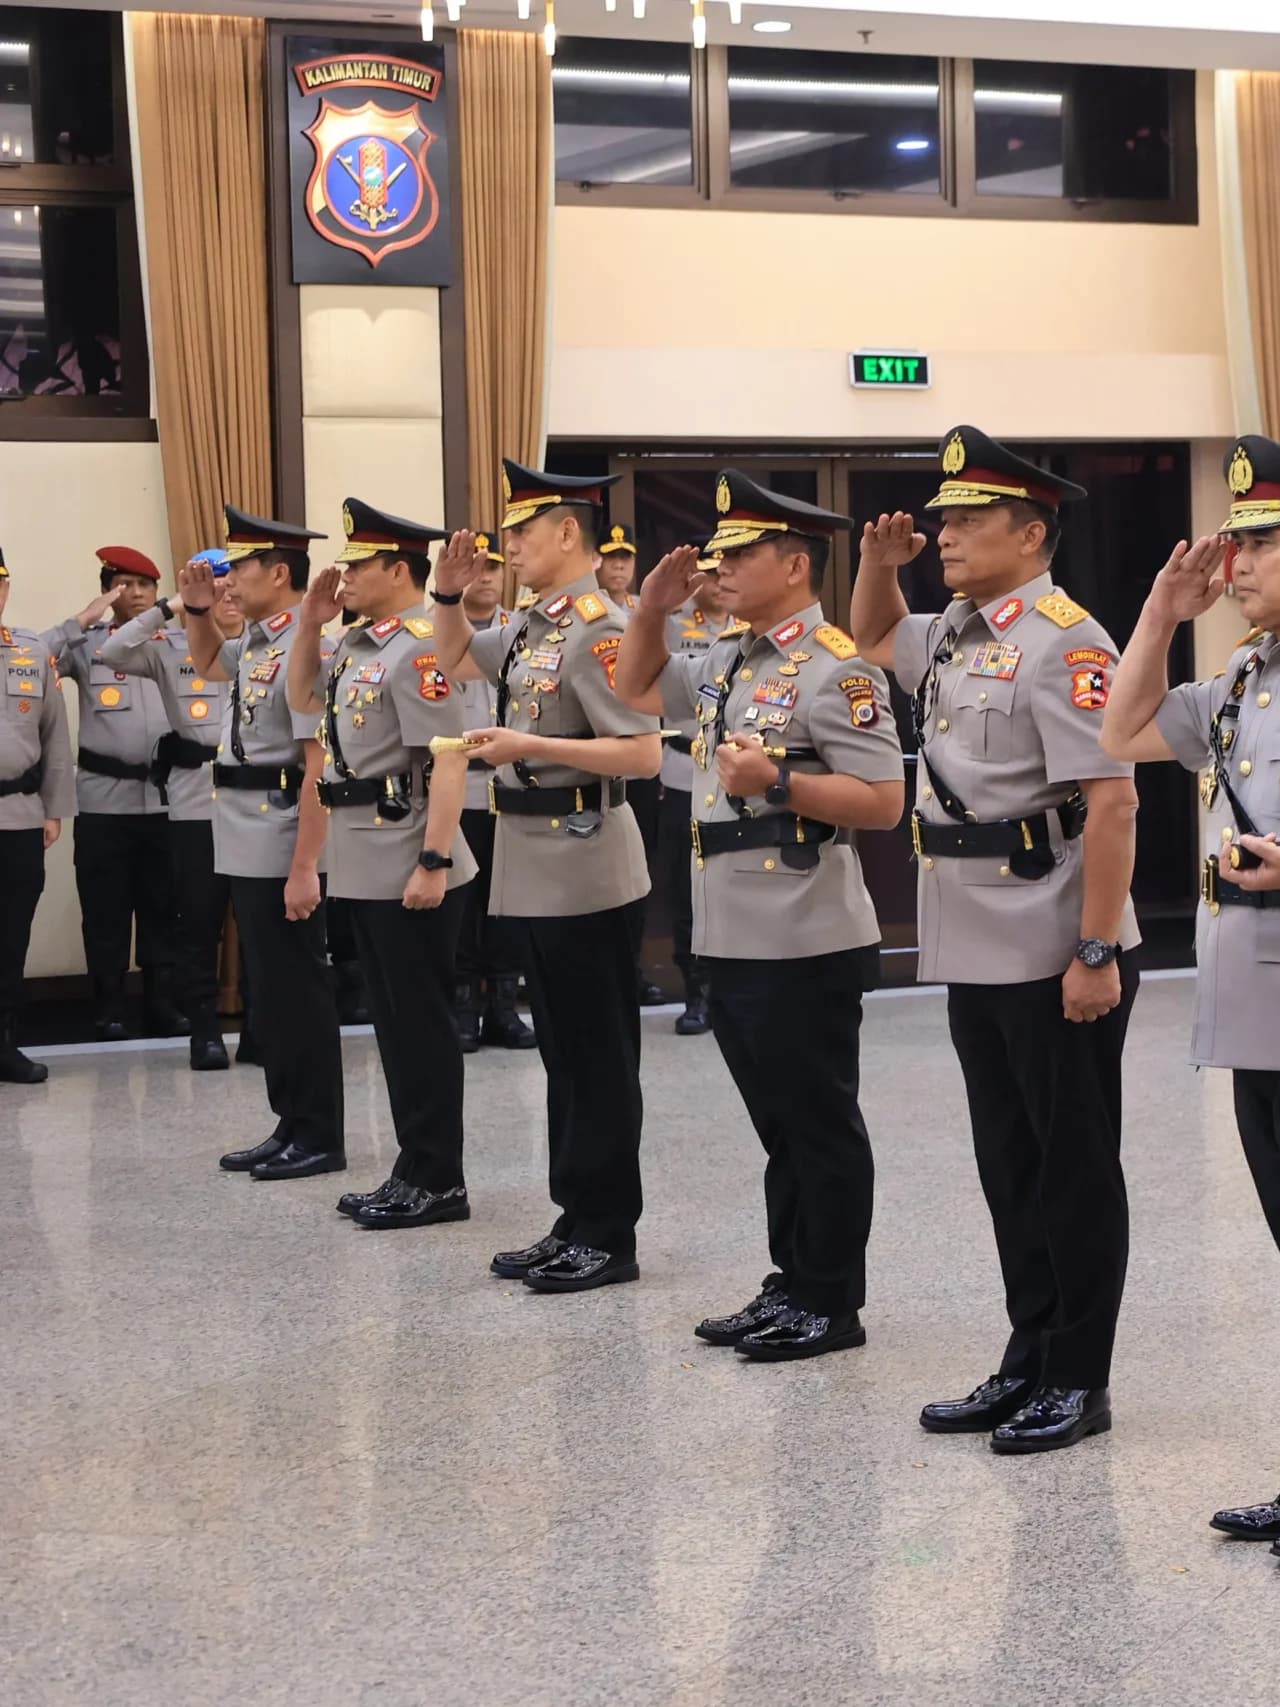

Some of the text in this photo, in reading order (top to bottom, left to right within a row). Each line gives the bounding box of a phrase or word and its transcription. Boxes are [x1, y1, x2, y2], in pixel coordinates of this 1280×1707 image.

[303, 61, 432, 91] KALIMANTAN TIMUR
[863, 357, 919, 382] EXIT
[840, 678, 870, 690] POLDA
